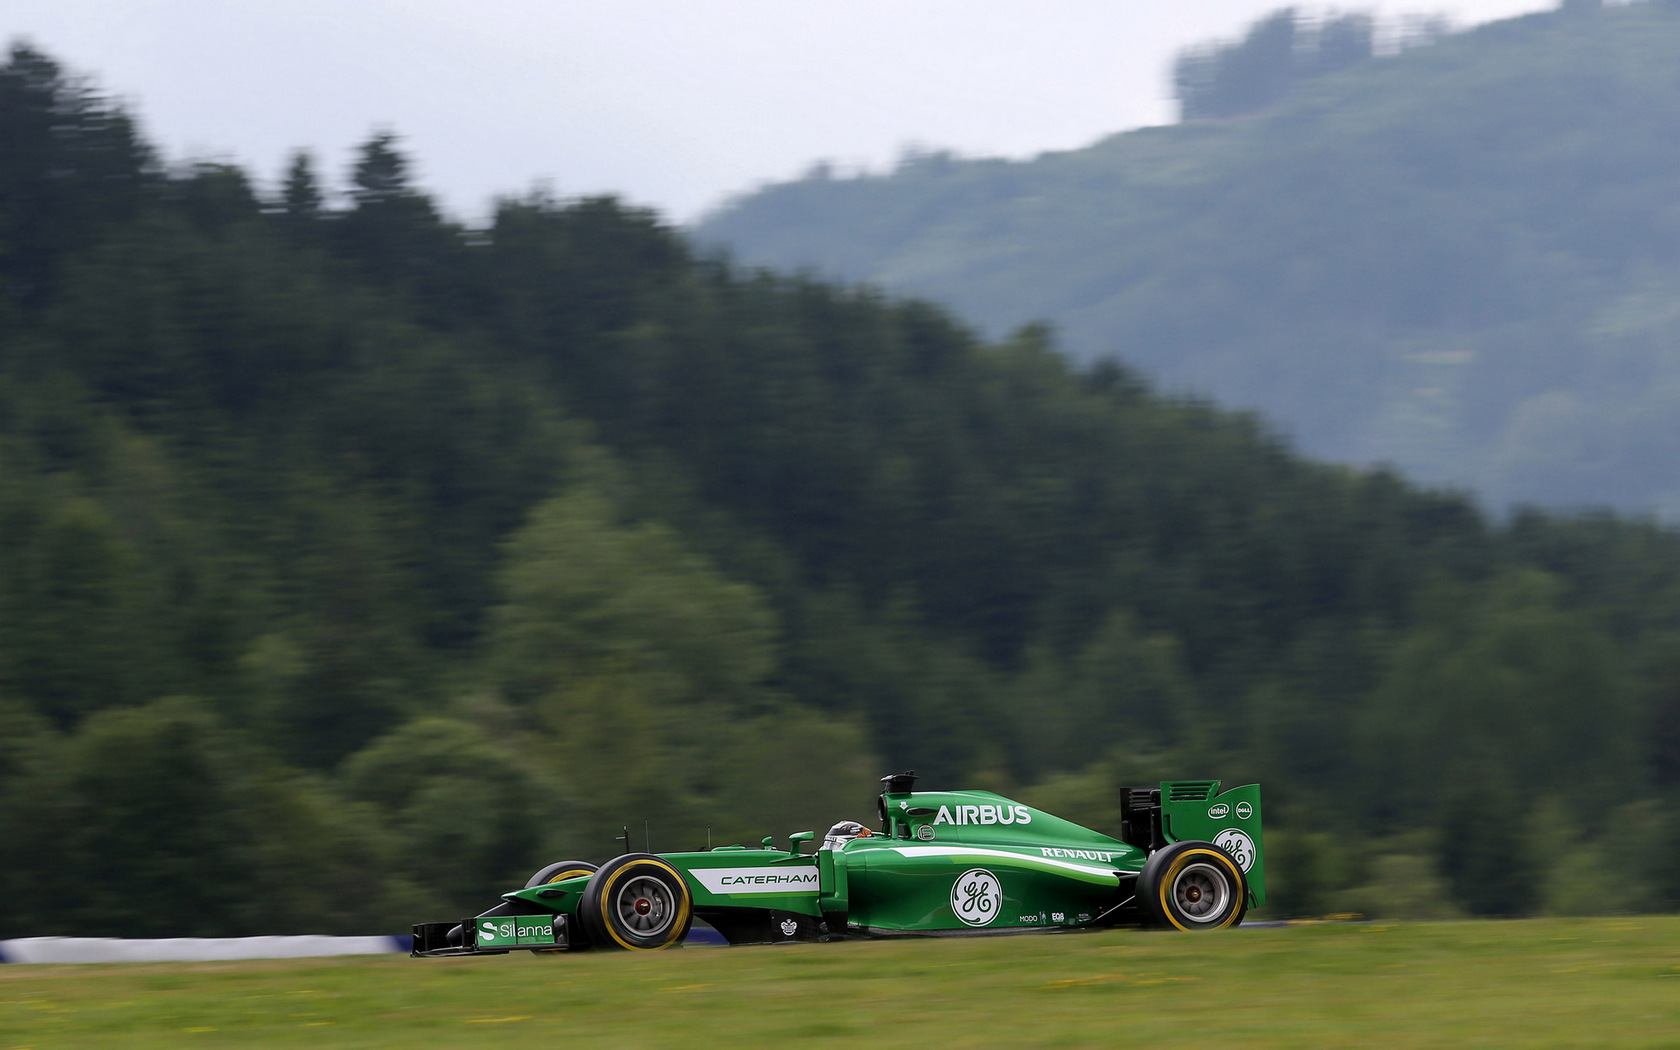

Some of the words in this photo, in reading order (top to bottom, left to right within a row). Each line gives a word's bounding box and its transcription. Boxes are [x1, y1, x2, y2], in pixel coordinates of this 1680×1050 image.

[932, 805, 1032, 825] AIRBUS
[1210, 807, 1227, 815] intel
[1040, 847, 1113, 863] RENAULT
[721, 874, 818, 885] CATERHAM
[500, 924, 553, 938] Silanna
